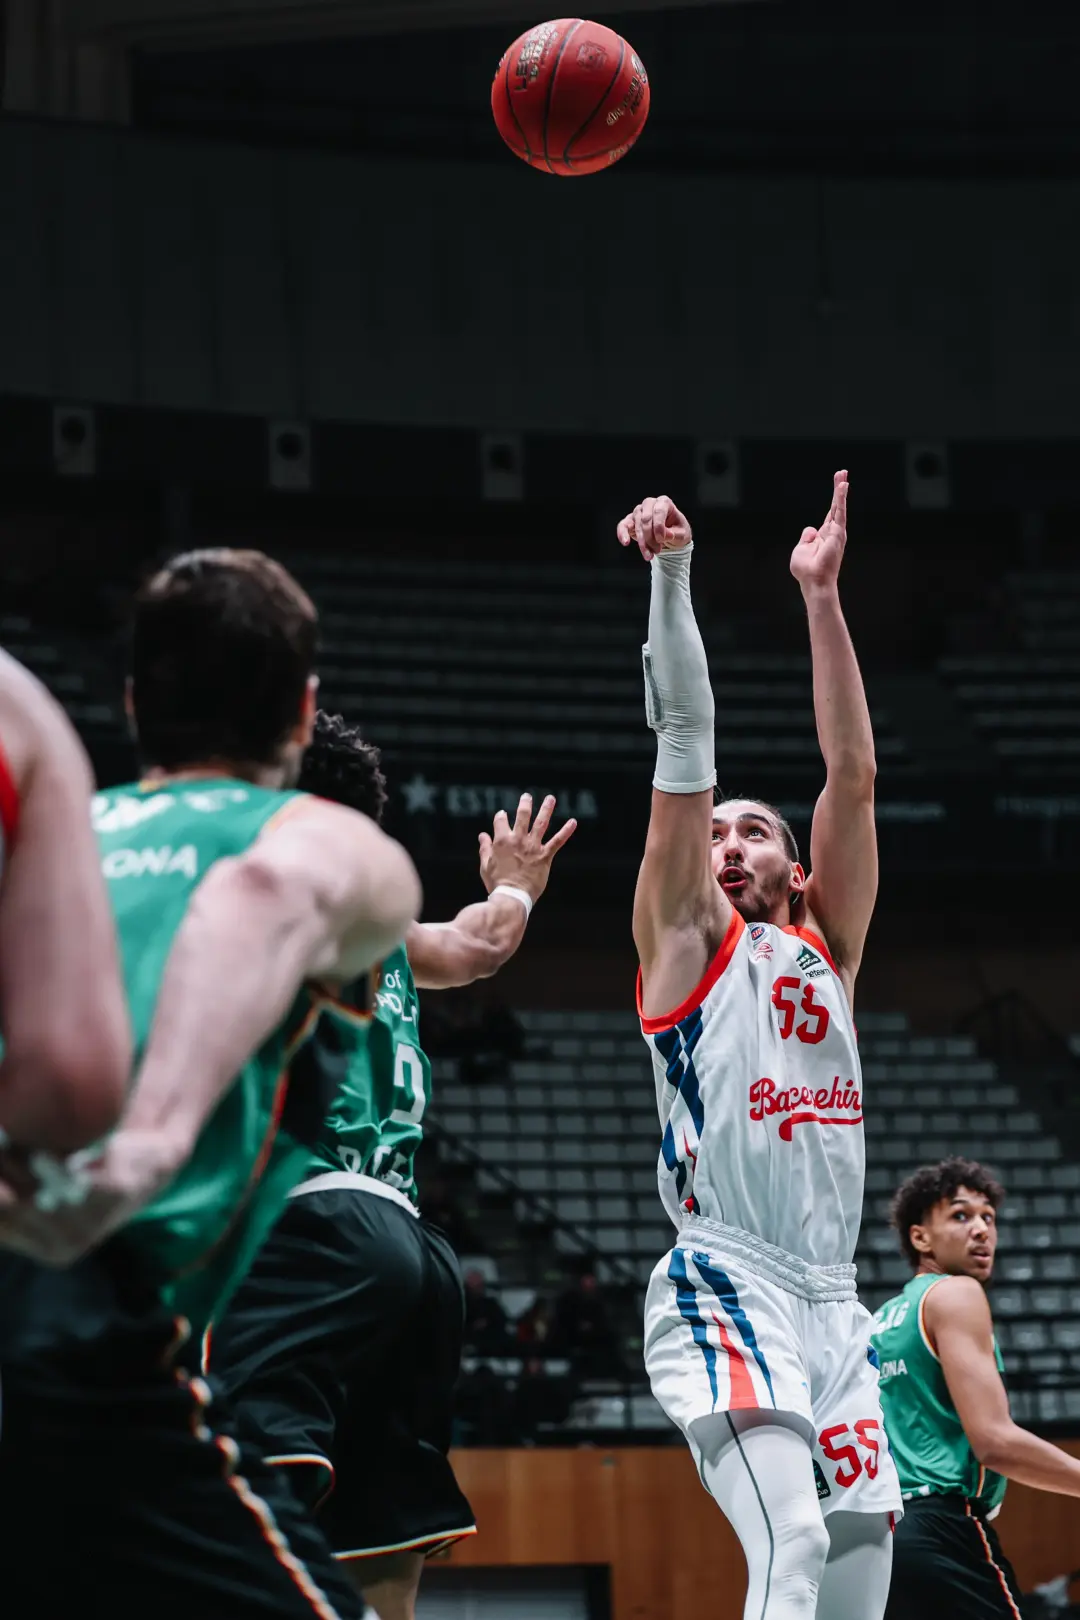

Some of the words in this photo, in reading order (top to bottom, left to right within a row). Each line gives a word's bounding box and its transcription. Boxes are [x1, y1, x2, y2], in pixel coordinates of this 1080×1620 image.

[385, 969, 402, 989] of
[805, 968, 831, 978] neteam
[771, 975, 830, 1044] 55
[818, 1419, 879, 1488] 55
[817, 1488, 829, 1496] Cup
